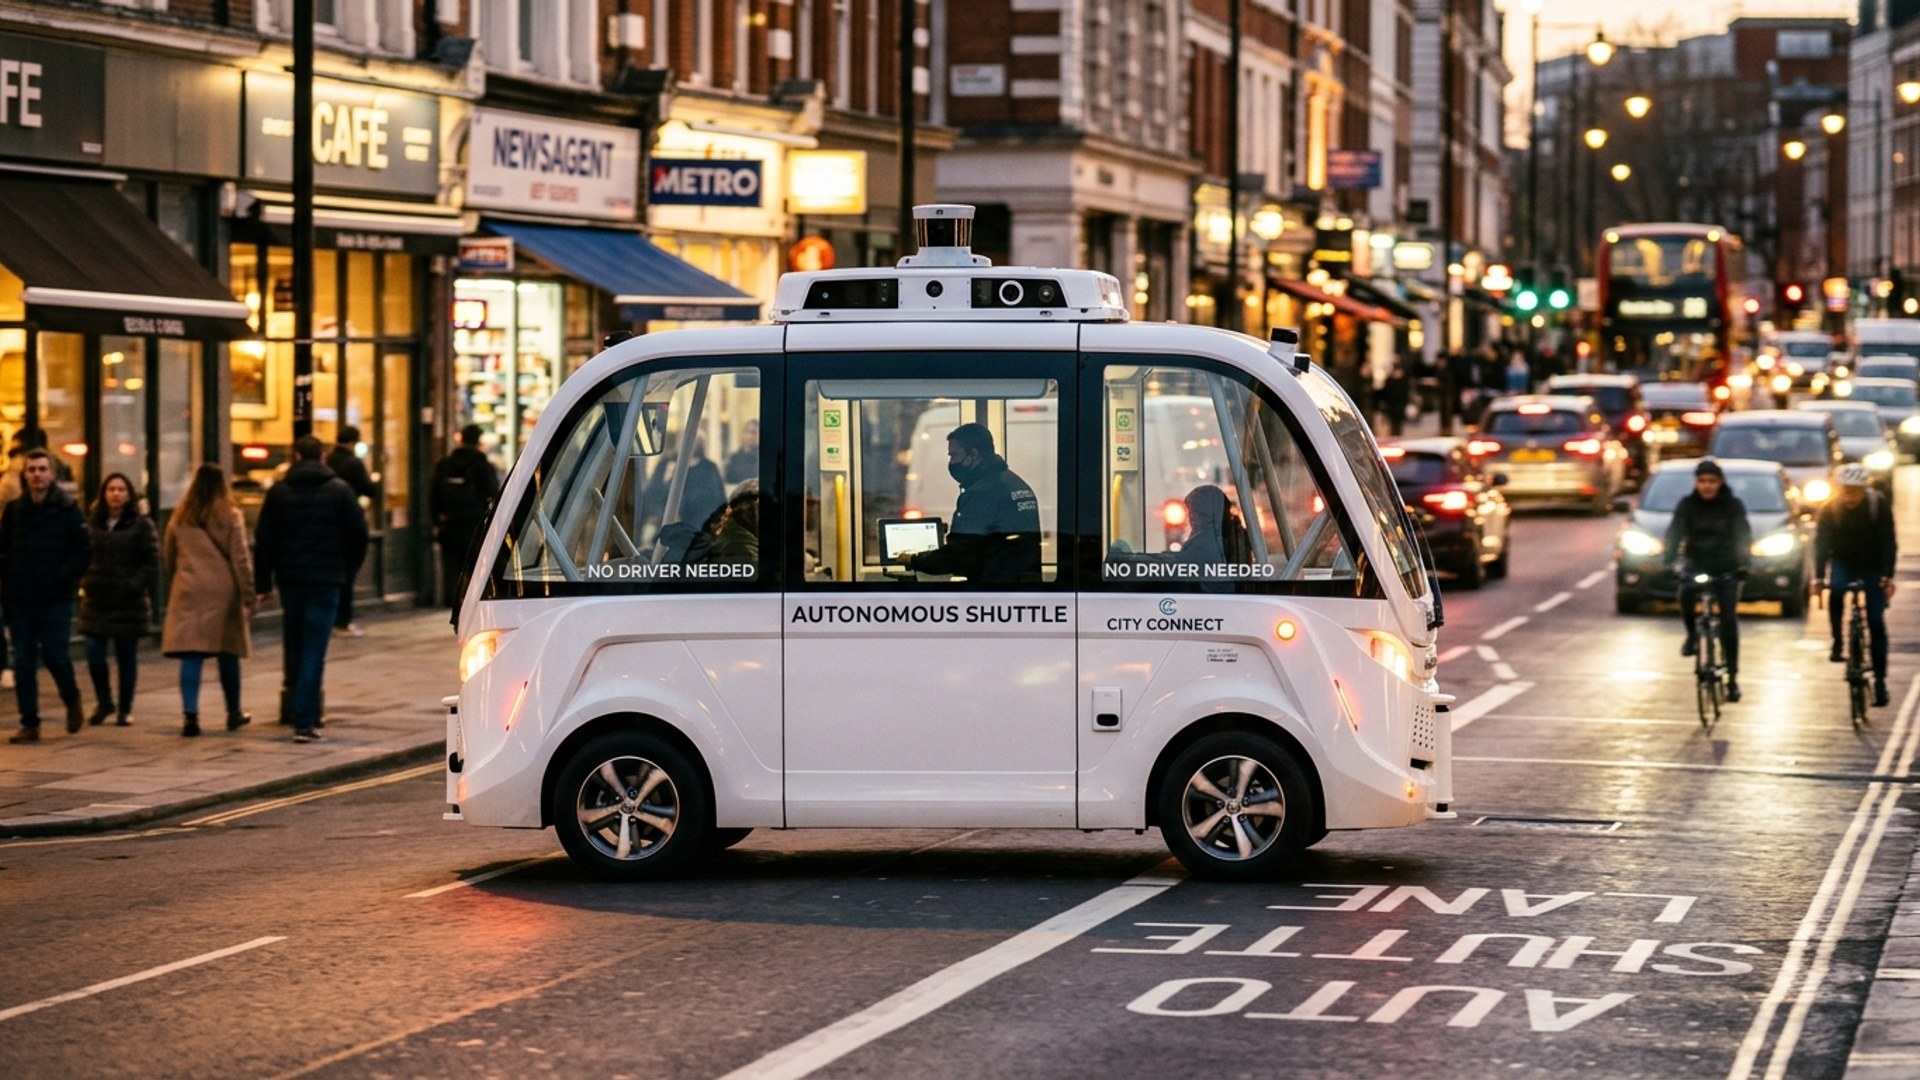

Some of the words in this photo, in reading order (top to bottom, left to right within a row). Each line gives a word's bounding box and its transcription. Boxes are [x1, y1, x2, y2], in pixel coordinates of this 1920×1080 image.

[493, 127, 614, 179] NEWSAGENT
[653, 167, 758, 196] METRO
[588, 564, 615, 578] NO
[619, 564, 680, 578] DRIVER
[686, 564, 755, 578] NEEDED
[1105, 563, 1131, 577] NO
[1136, 563, 1199, 577] DRIVER
[791, 605, 960, 623] AUTONOMOUS
[966, 605, 1067, 623] SHUTTLE
[1107, 618, 1142, 631] CITY
[1146, 618, 1224, 631] CONNECT
[1266, 883, 1698, 923] LANE
[1090, 922, 1764, 976] SHUTTE
[1126, 977, 1639, 1032] AUTO
